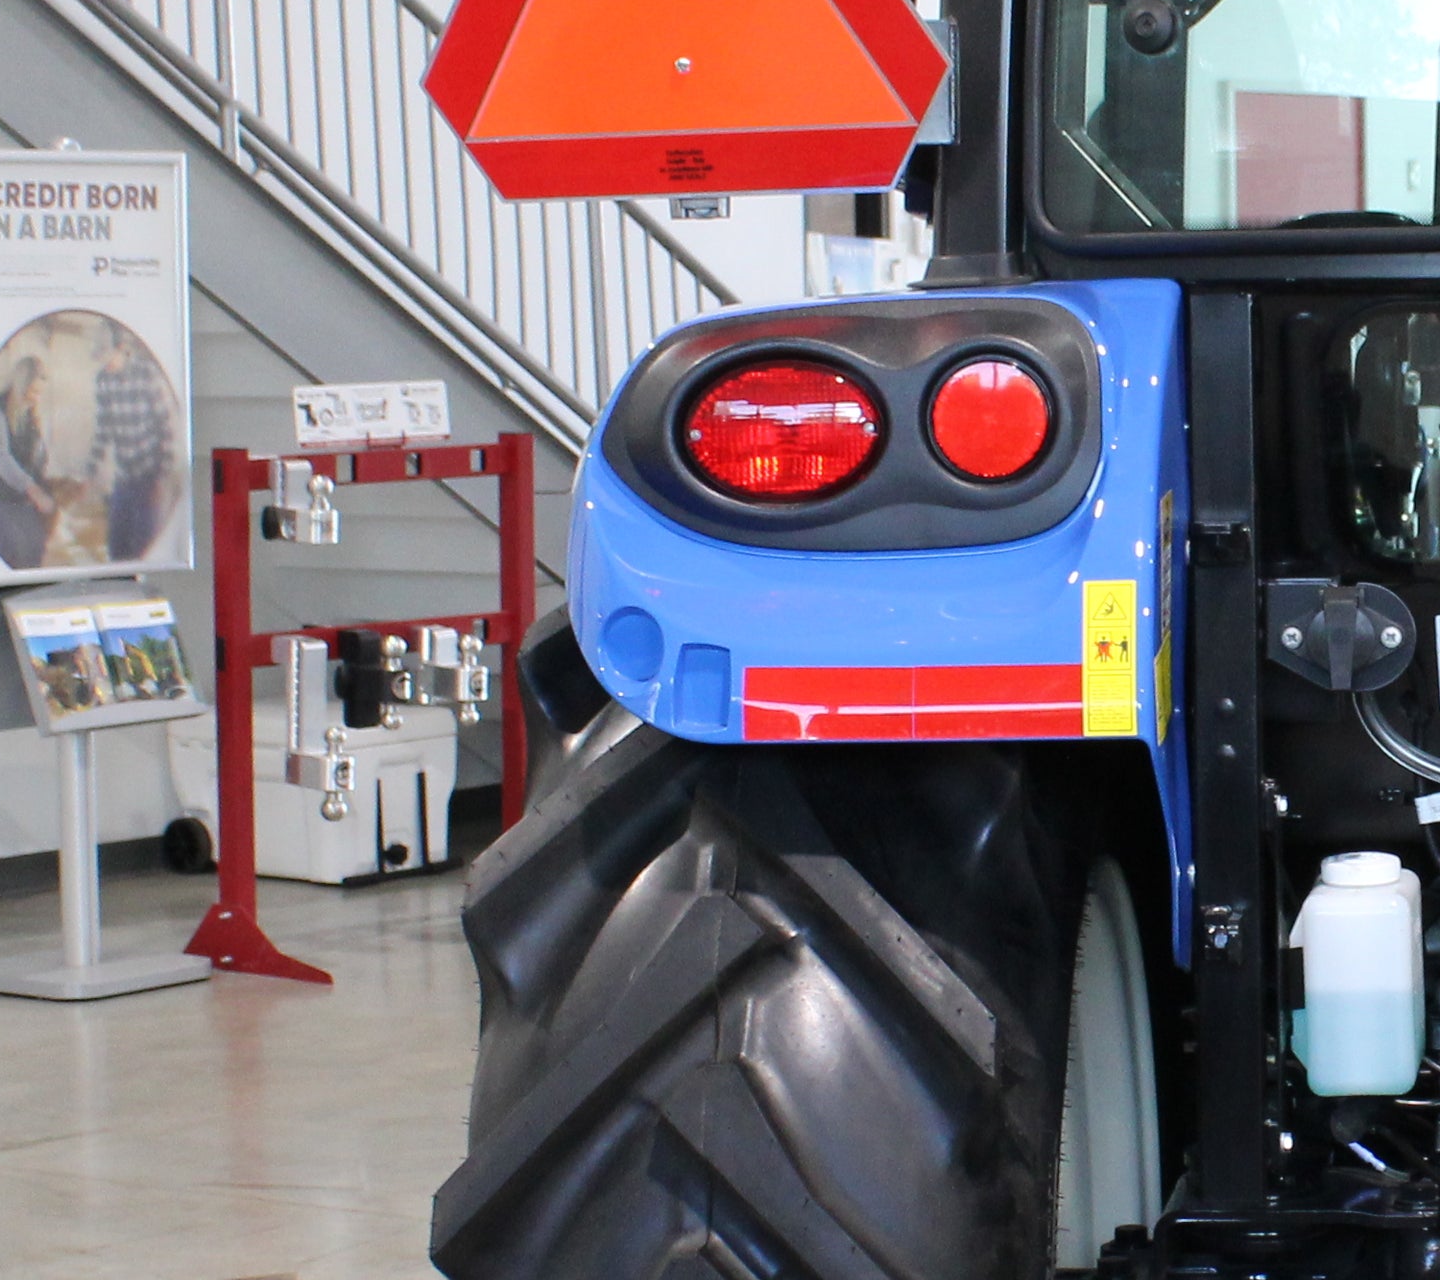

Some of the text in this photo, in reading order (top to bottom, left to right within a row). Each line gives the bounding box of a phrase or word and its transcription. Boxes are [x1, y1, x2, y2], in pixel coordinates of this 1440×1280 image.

[87, 184, 158, 210] BORN
[18, 214, 36, 239] A
[43, 214, 112, 240] BARN
